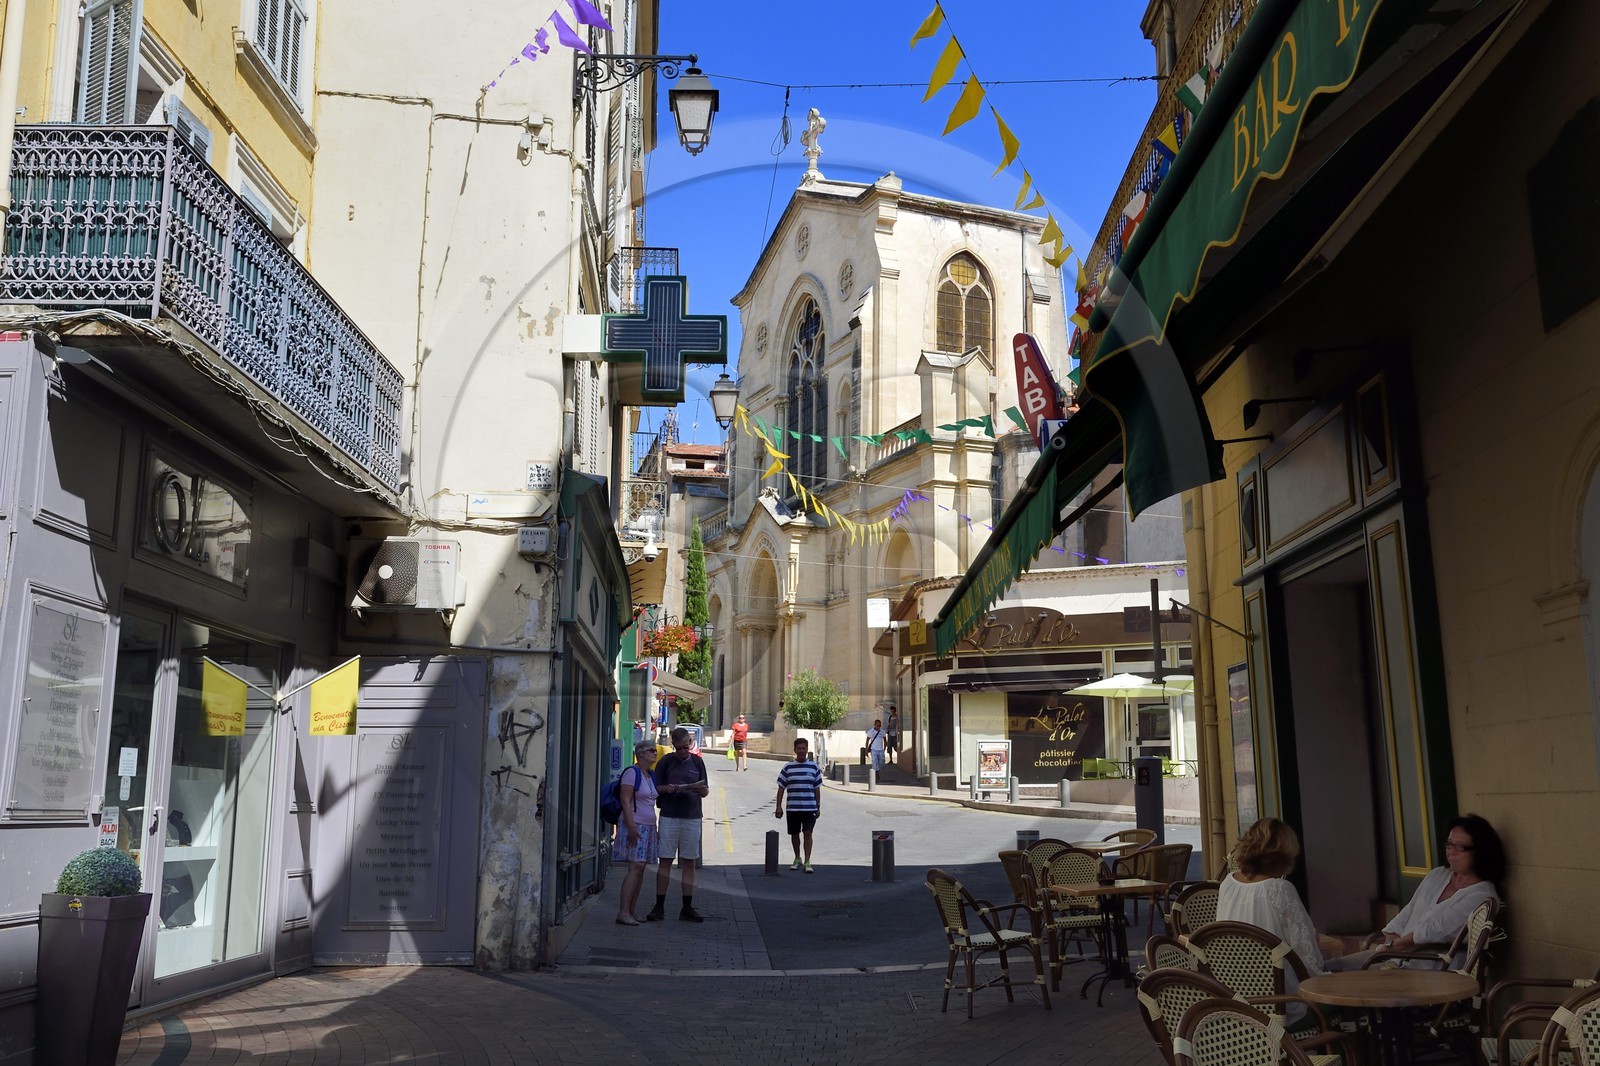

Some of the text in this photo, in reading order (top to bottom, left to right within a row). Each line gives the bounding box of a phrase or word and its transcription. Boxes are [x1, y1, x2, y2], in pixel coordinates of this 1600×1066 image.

[1231, 31, 1301, 193] BAR
[313, 711, 352, 722] Benvenuto
[1030, 702, 1085, 731] Le Palet
[313, 724, 325, 732] via
[1048, 720, 1076, 741] d'Or
[1040, 748, 1076, 759] pâtissier
[101, 838, 116, 846] BACH
